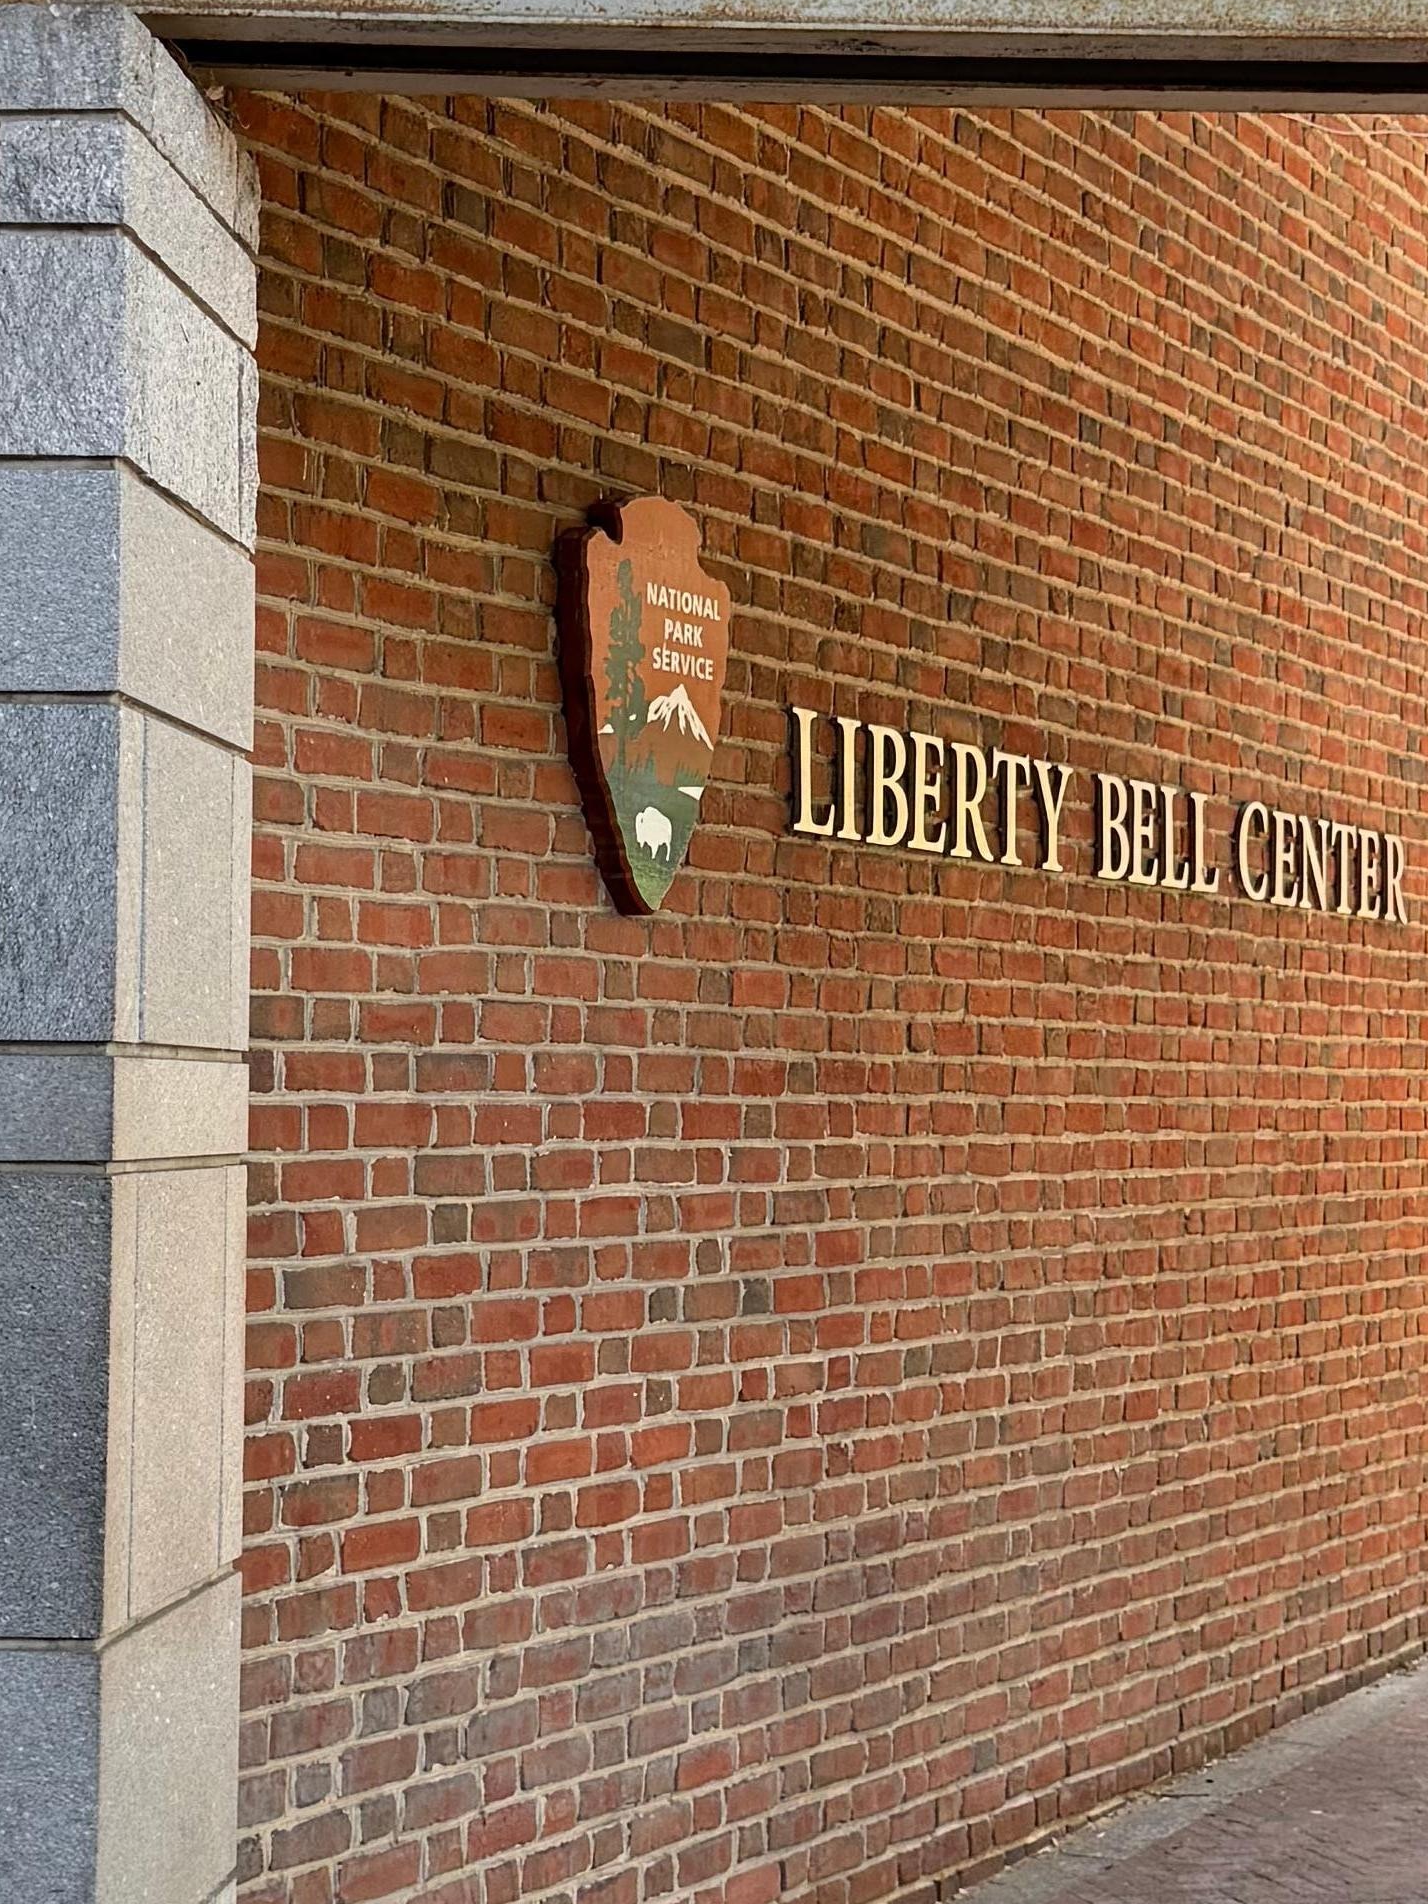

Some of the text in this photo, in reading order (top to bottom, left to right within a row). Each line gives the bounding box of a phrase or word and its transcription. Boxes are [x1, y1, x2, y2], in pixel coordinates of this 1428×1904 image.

[646, 581, 721, 621] NATIONAL
[664, 618, 703, 648] PARK
[652, 646, 714, 681] SERVICE
[792, 706, 1408, 924] LIBERTY BELL CENTER
